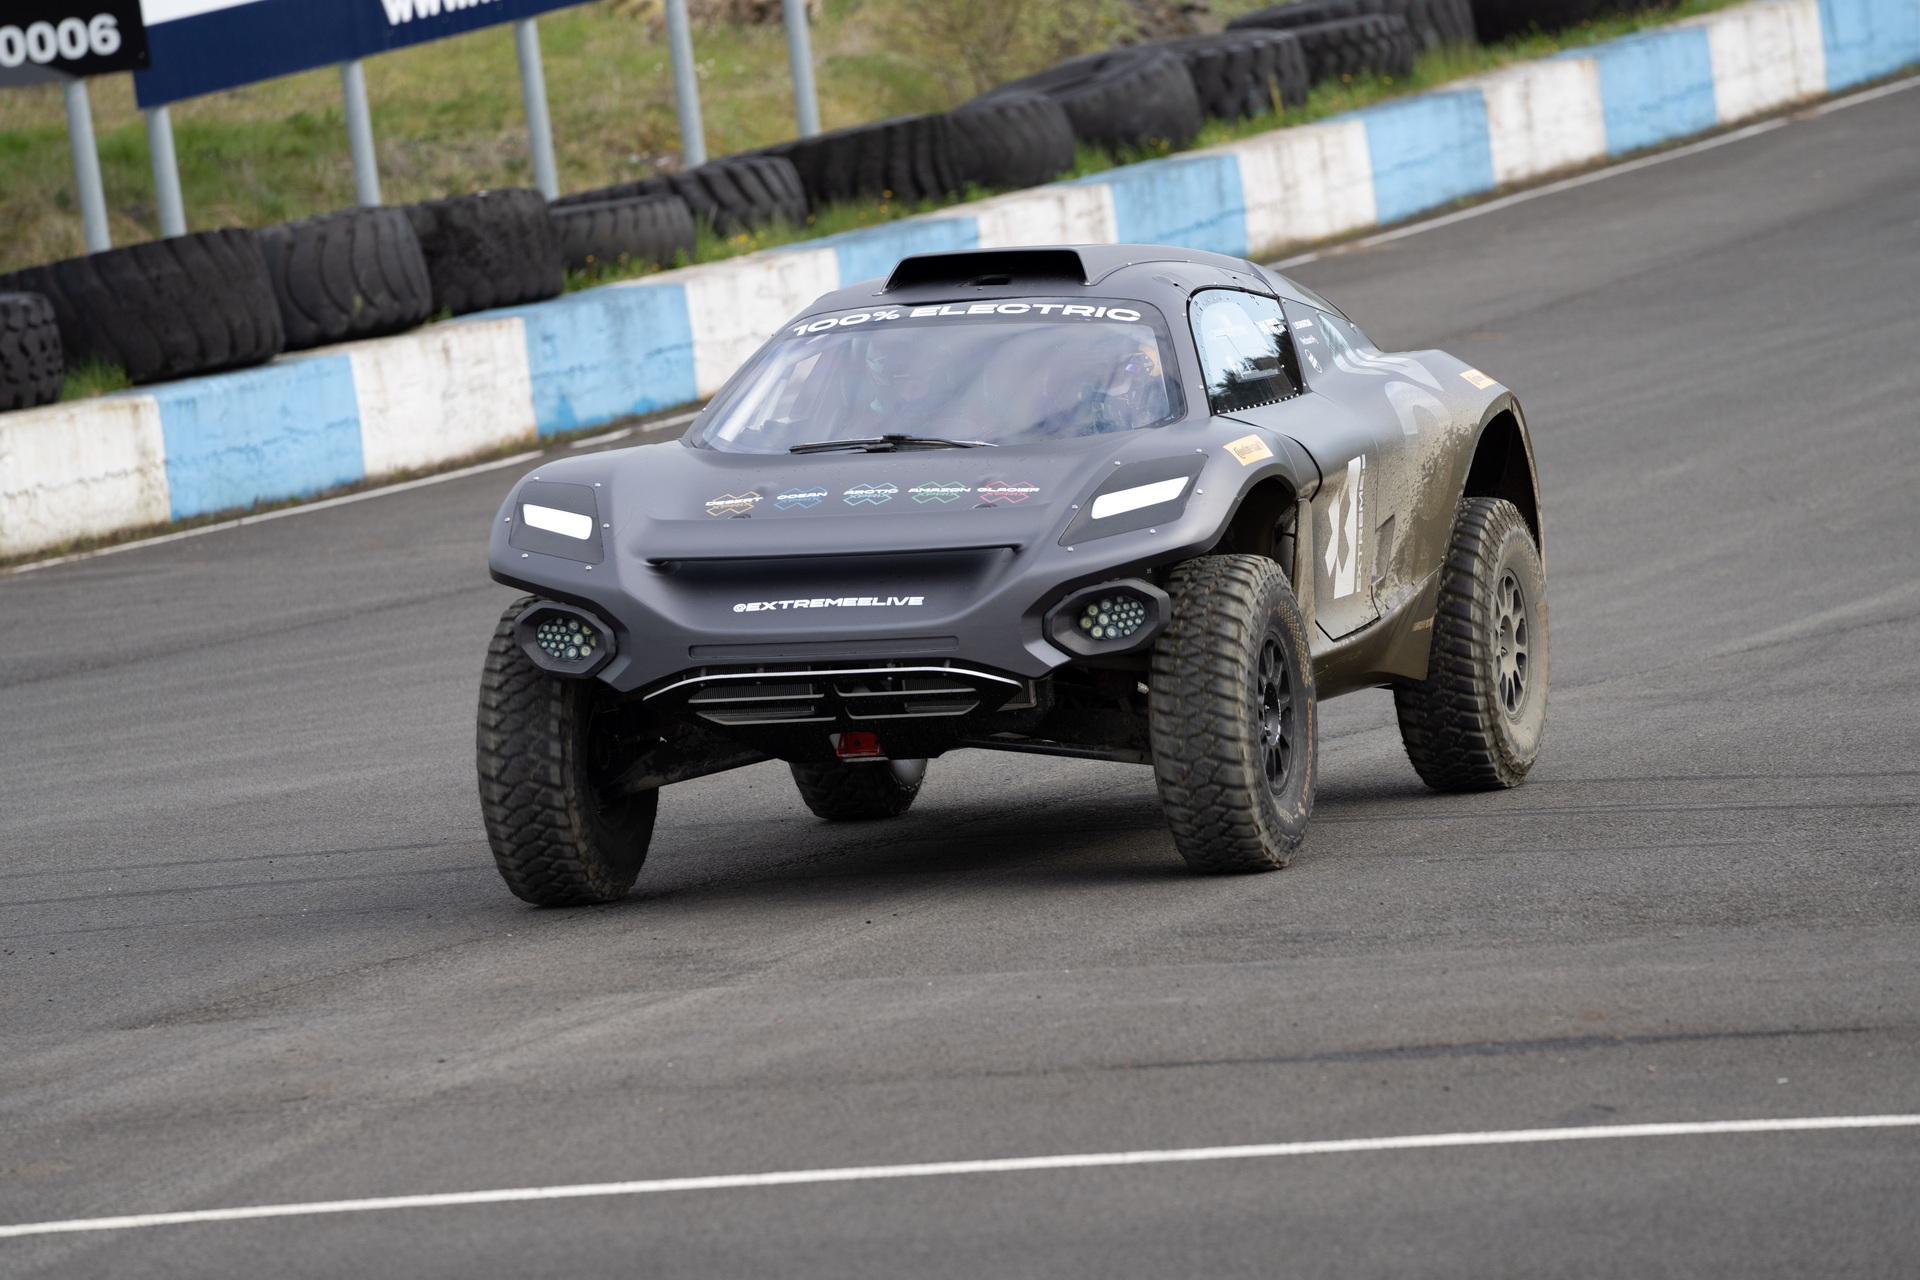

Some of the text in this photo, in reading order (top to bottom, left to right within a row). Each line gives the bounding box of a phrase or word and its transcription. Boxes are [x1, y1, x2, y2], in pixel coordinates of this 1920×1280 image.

[0, 12, 121, 68] 0006
[793, 303, 1141, 337] 100% ELECTRIC
[705, 496, 763, 506] DESERT
[777, 491, 828, 500] OCEAN
[733, 596, 924, 612] @EXTREMEELIVE
